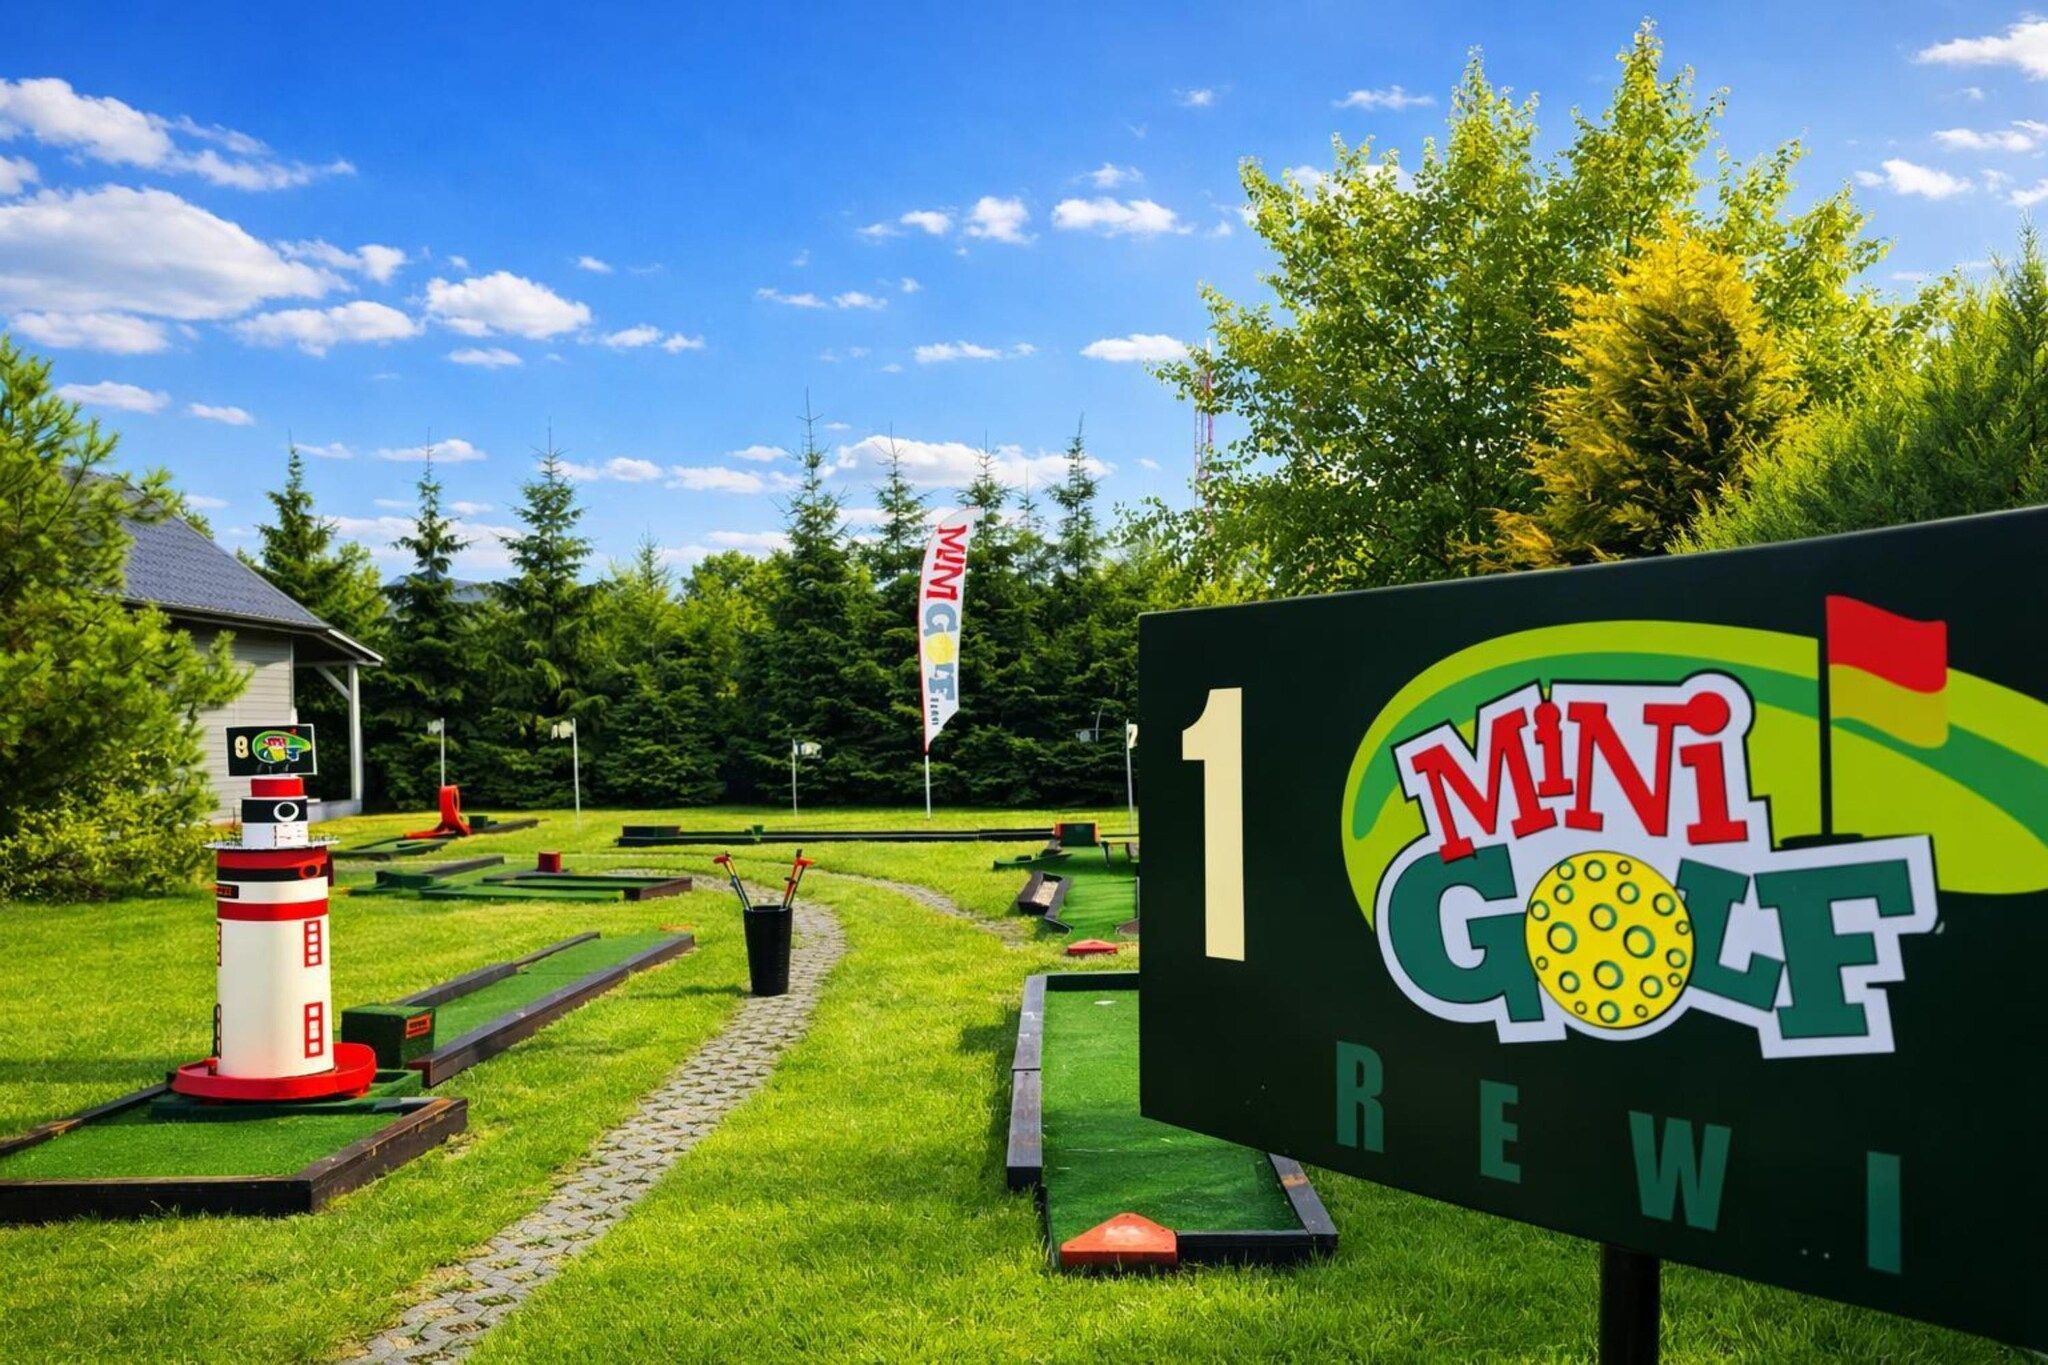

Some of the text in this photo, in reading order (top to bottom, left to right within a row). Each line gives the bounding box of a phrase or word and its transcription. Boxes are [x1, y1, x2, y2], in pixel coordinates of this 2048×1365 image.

[924, 603, 958, 701] GOLF
[234, 735, 249, 759] 8
[1182, 687, 1245, 961] 1
[1388, 845, 1916, 1040] GOLF
